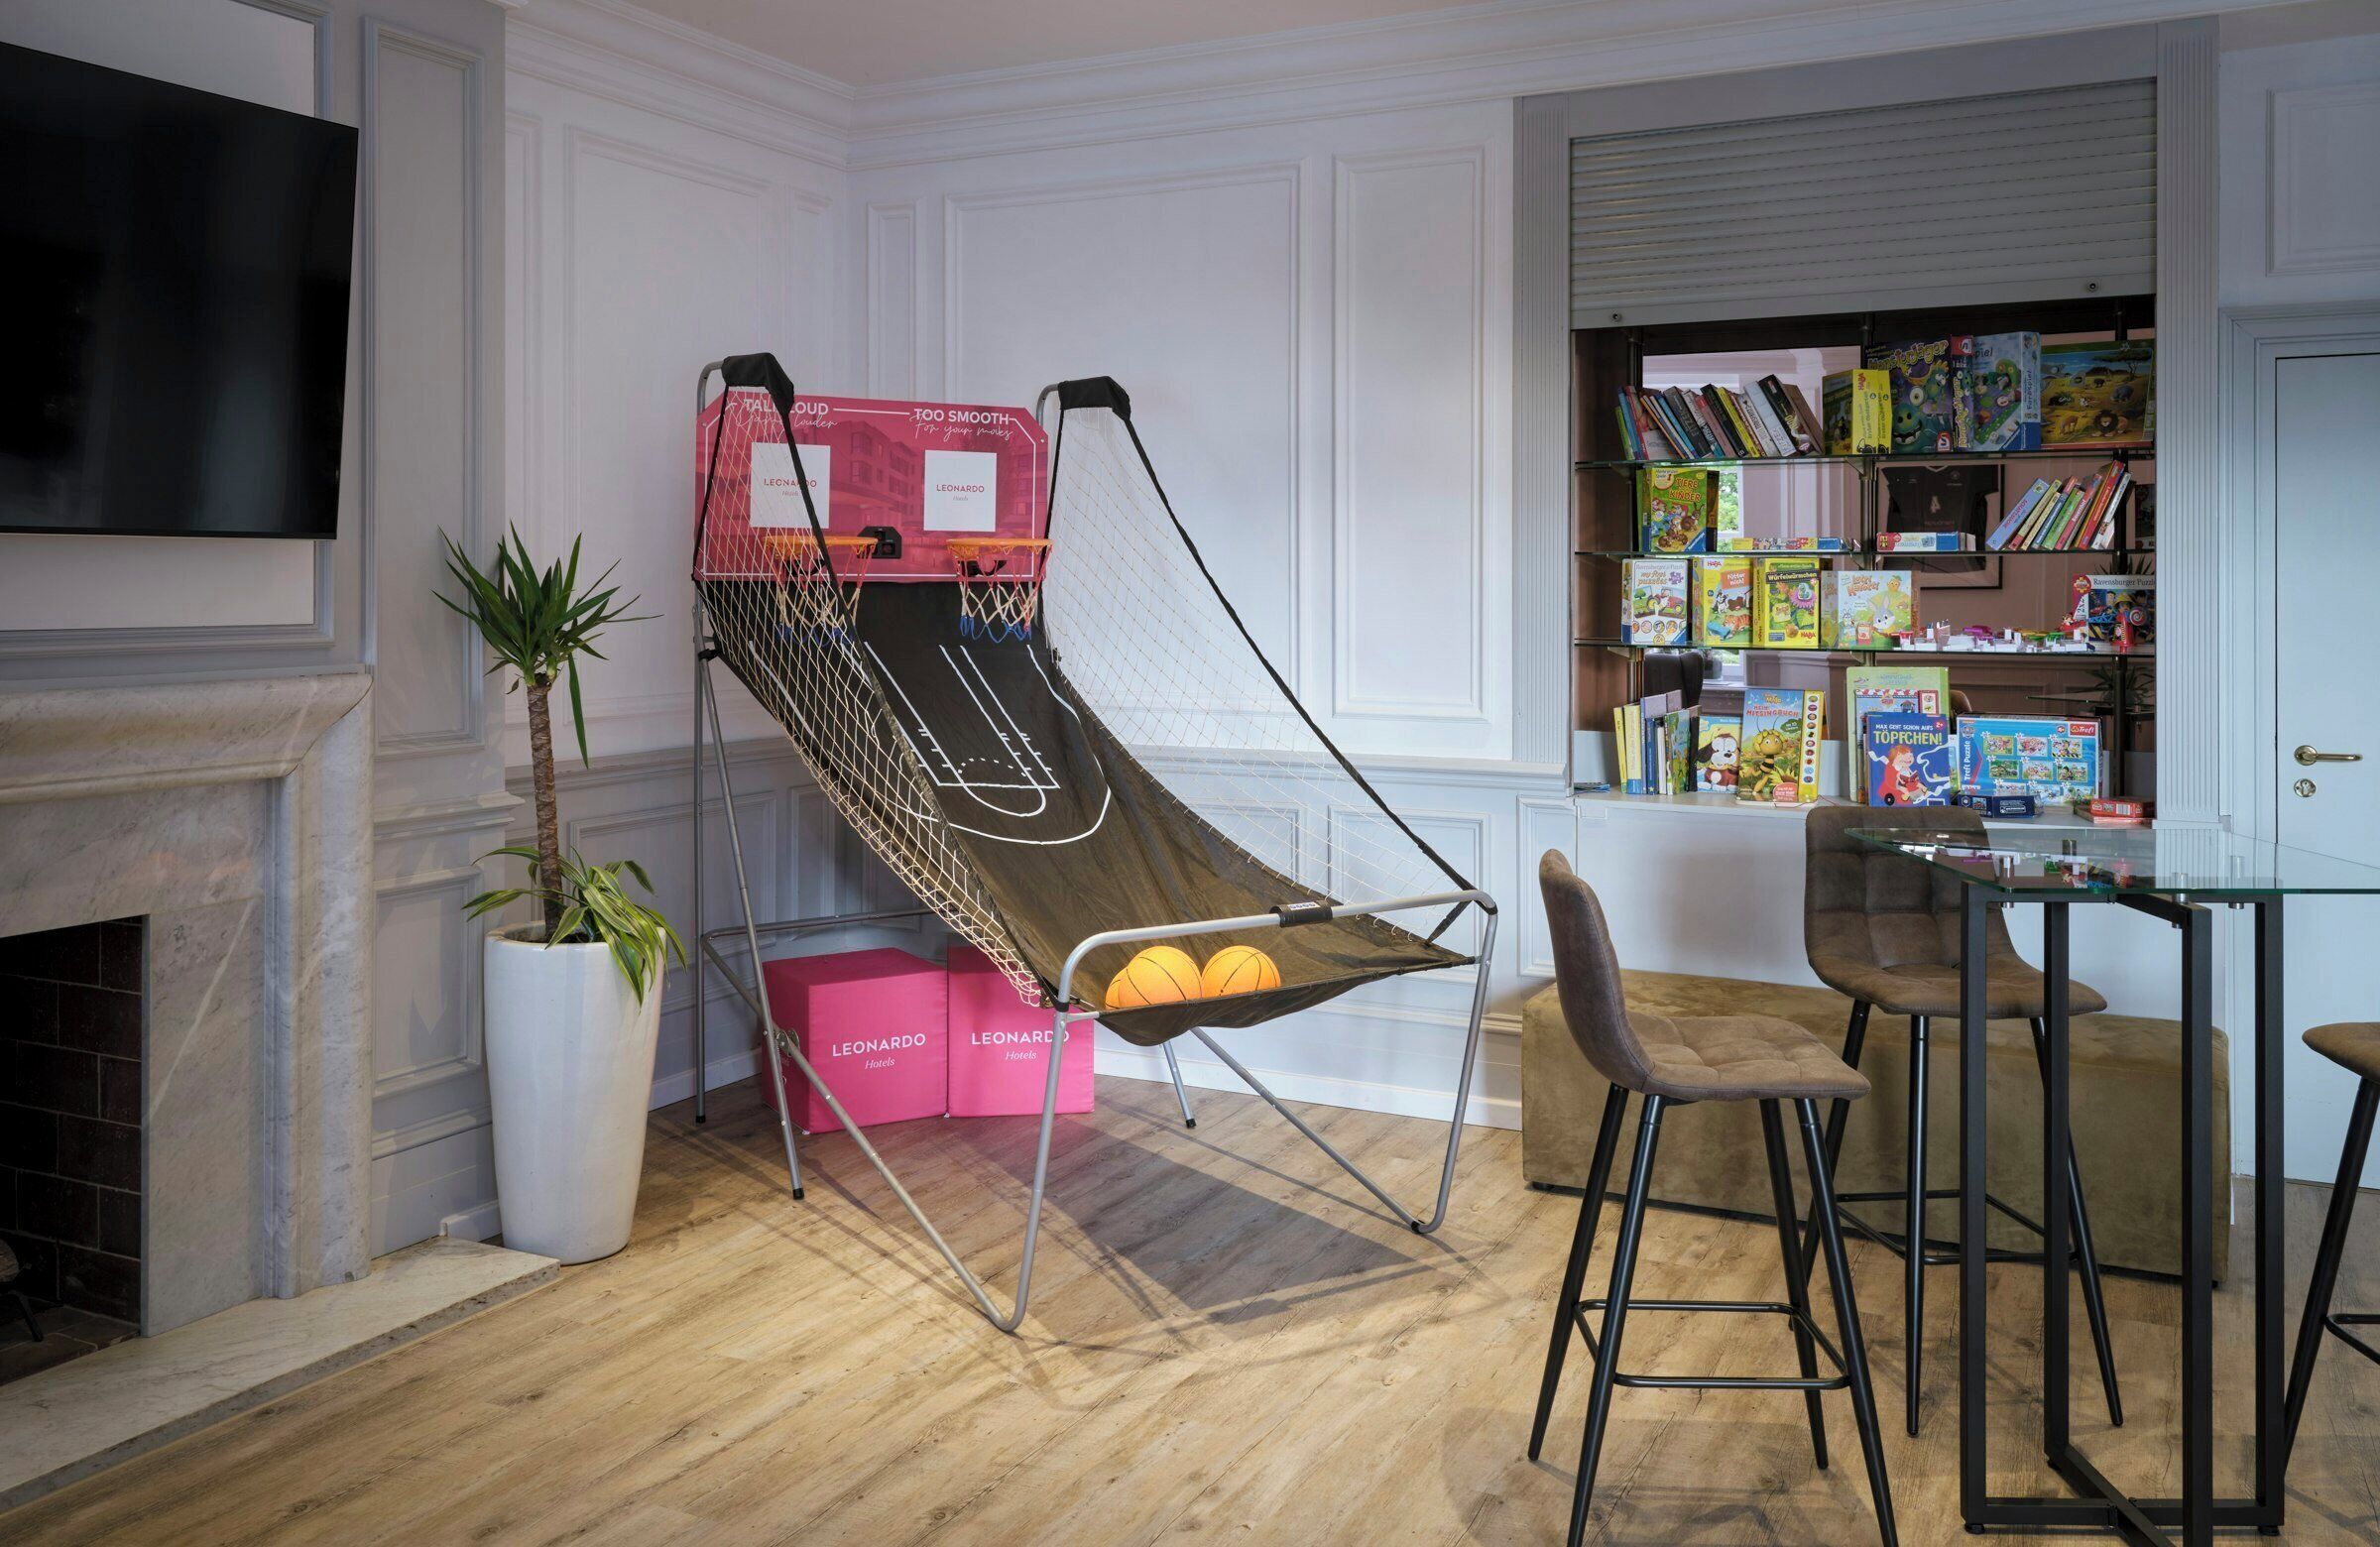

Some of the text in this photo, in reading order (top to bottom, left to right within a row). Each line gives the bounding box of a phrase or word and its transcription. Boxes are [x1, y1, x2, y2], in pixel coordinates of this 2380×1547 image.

[914, 409, 1009, 425] TOO SMOOTH
[943, 424, 973, 442] your
[977, 424, 1013, 441] moves
[936, 484, 985, 493] LEONARDO
[1676, 478, 1699, 489] TIERE
[1669, 490, 1702, 502] KINDER
[2093, 578, 2136, 587] Ravensburger
[1873, 729, 1943, 745] TÖPFCHEN!
[832, 1032, 926, 1057] LEONARDO
[1005, 1049, 1037, 1060] Hotels
[865, 1057, 895, 1069] Hotels
